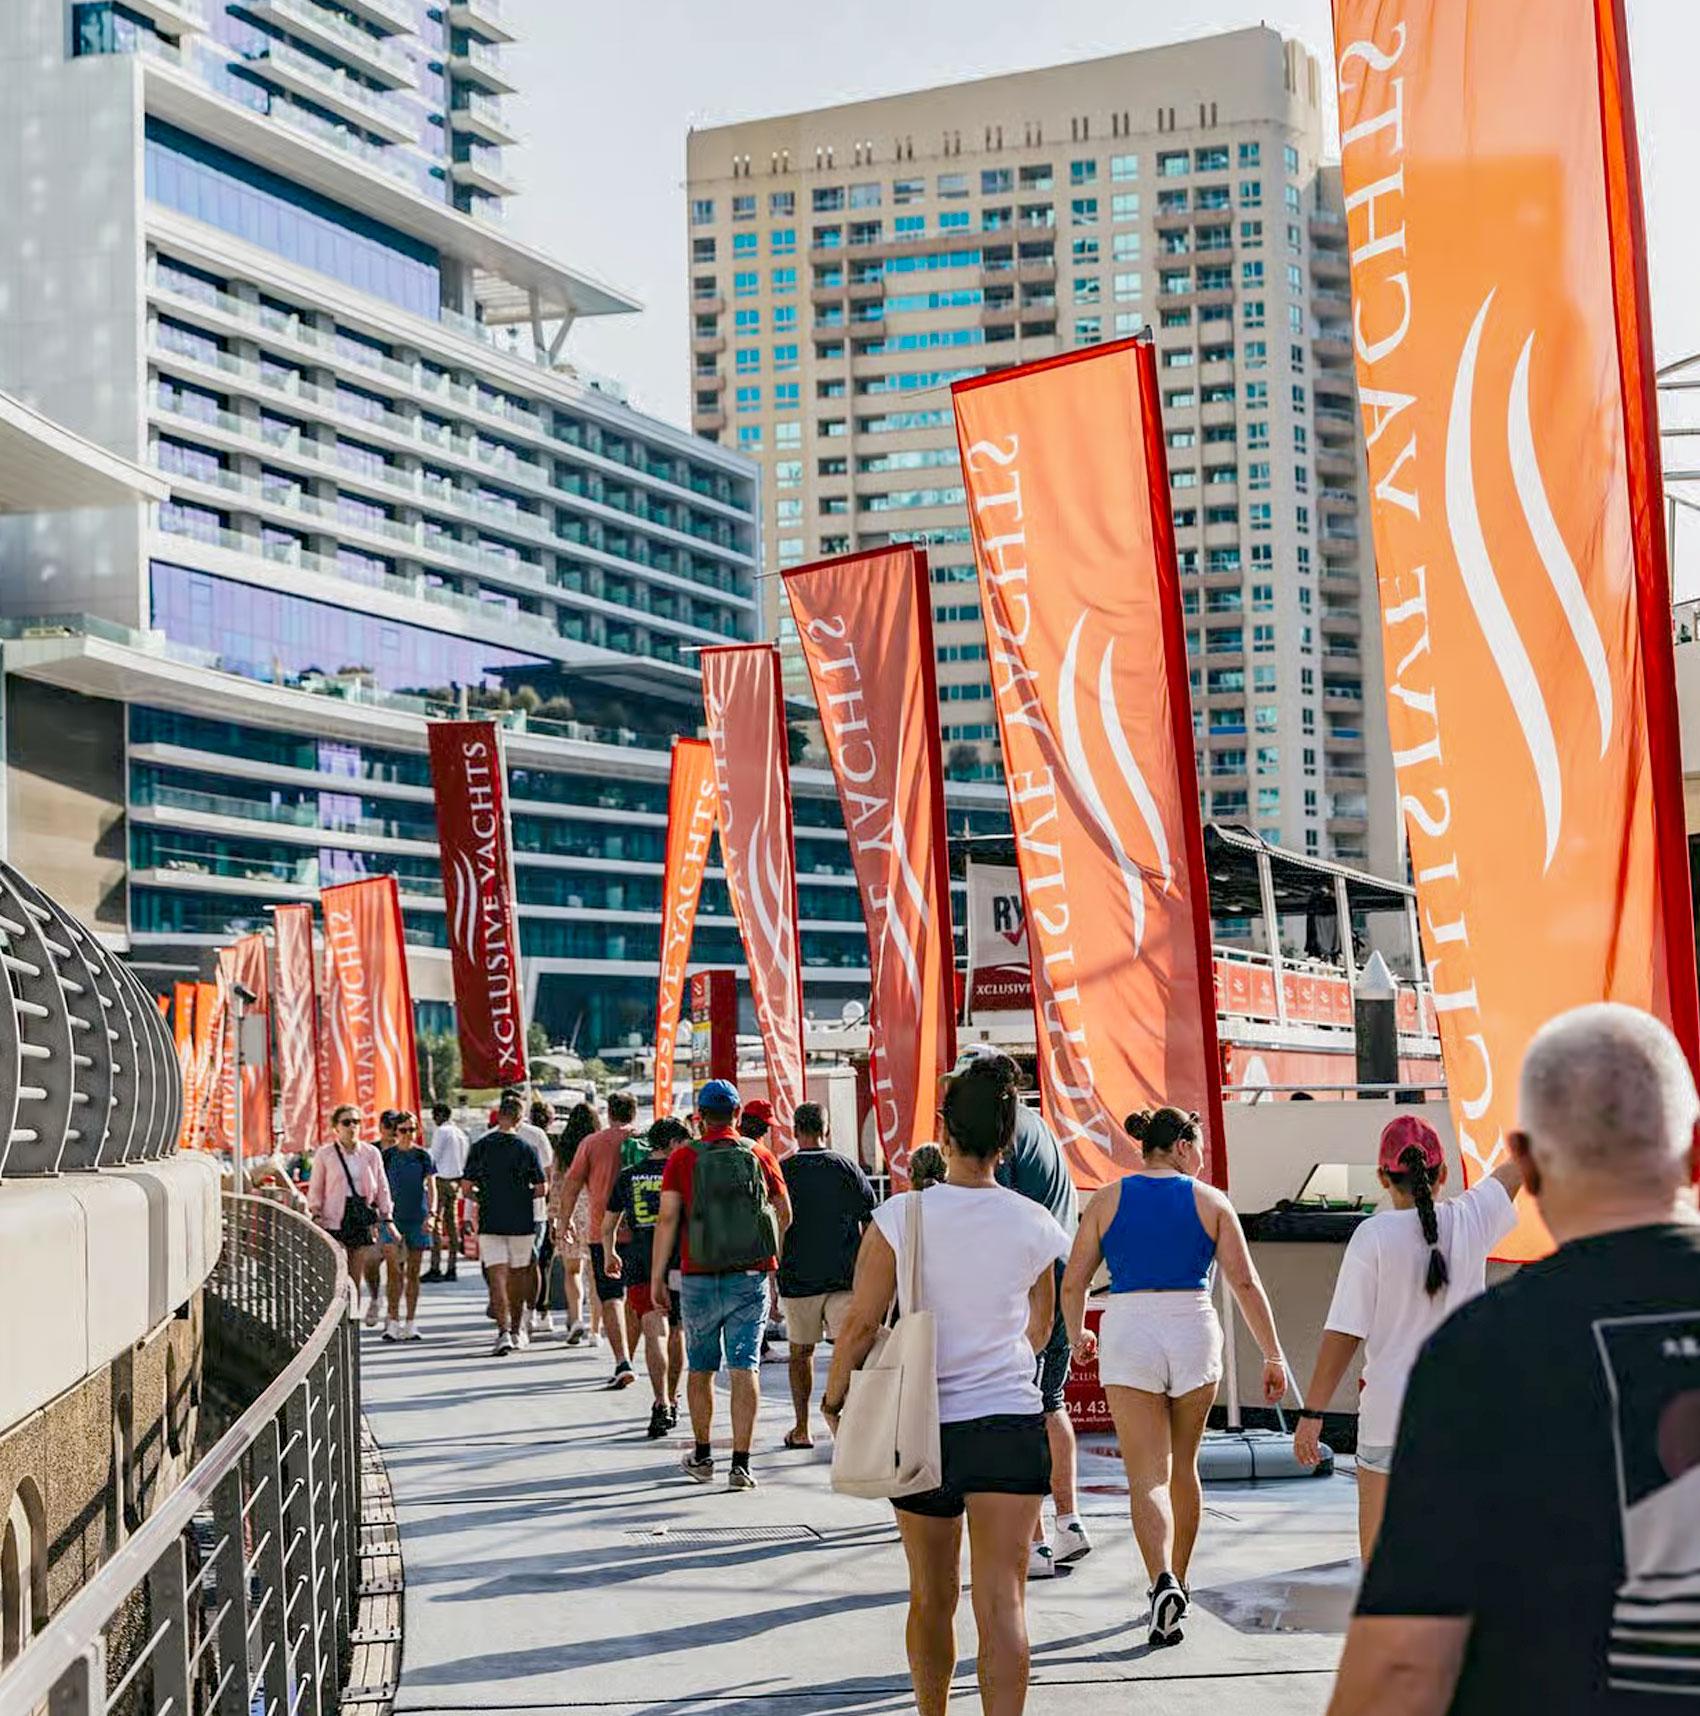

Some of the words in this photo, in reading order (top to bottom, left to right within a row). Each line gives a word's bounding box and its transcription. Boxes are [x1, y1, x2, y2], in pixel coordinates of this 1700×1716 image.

[462, 741, 497, 884] YACHTS
[668, 778, 718, 949] YACHTS
[483, 895, 518, 1067] XCLUSIVE
[660, 965, 681, 1111] LUSIVE
[1087, 1400, 1110, 1414] 43
